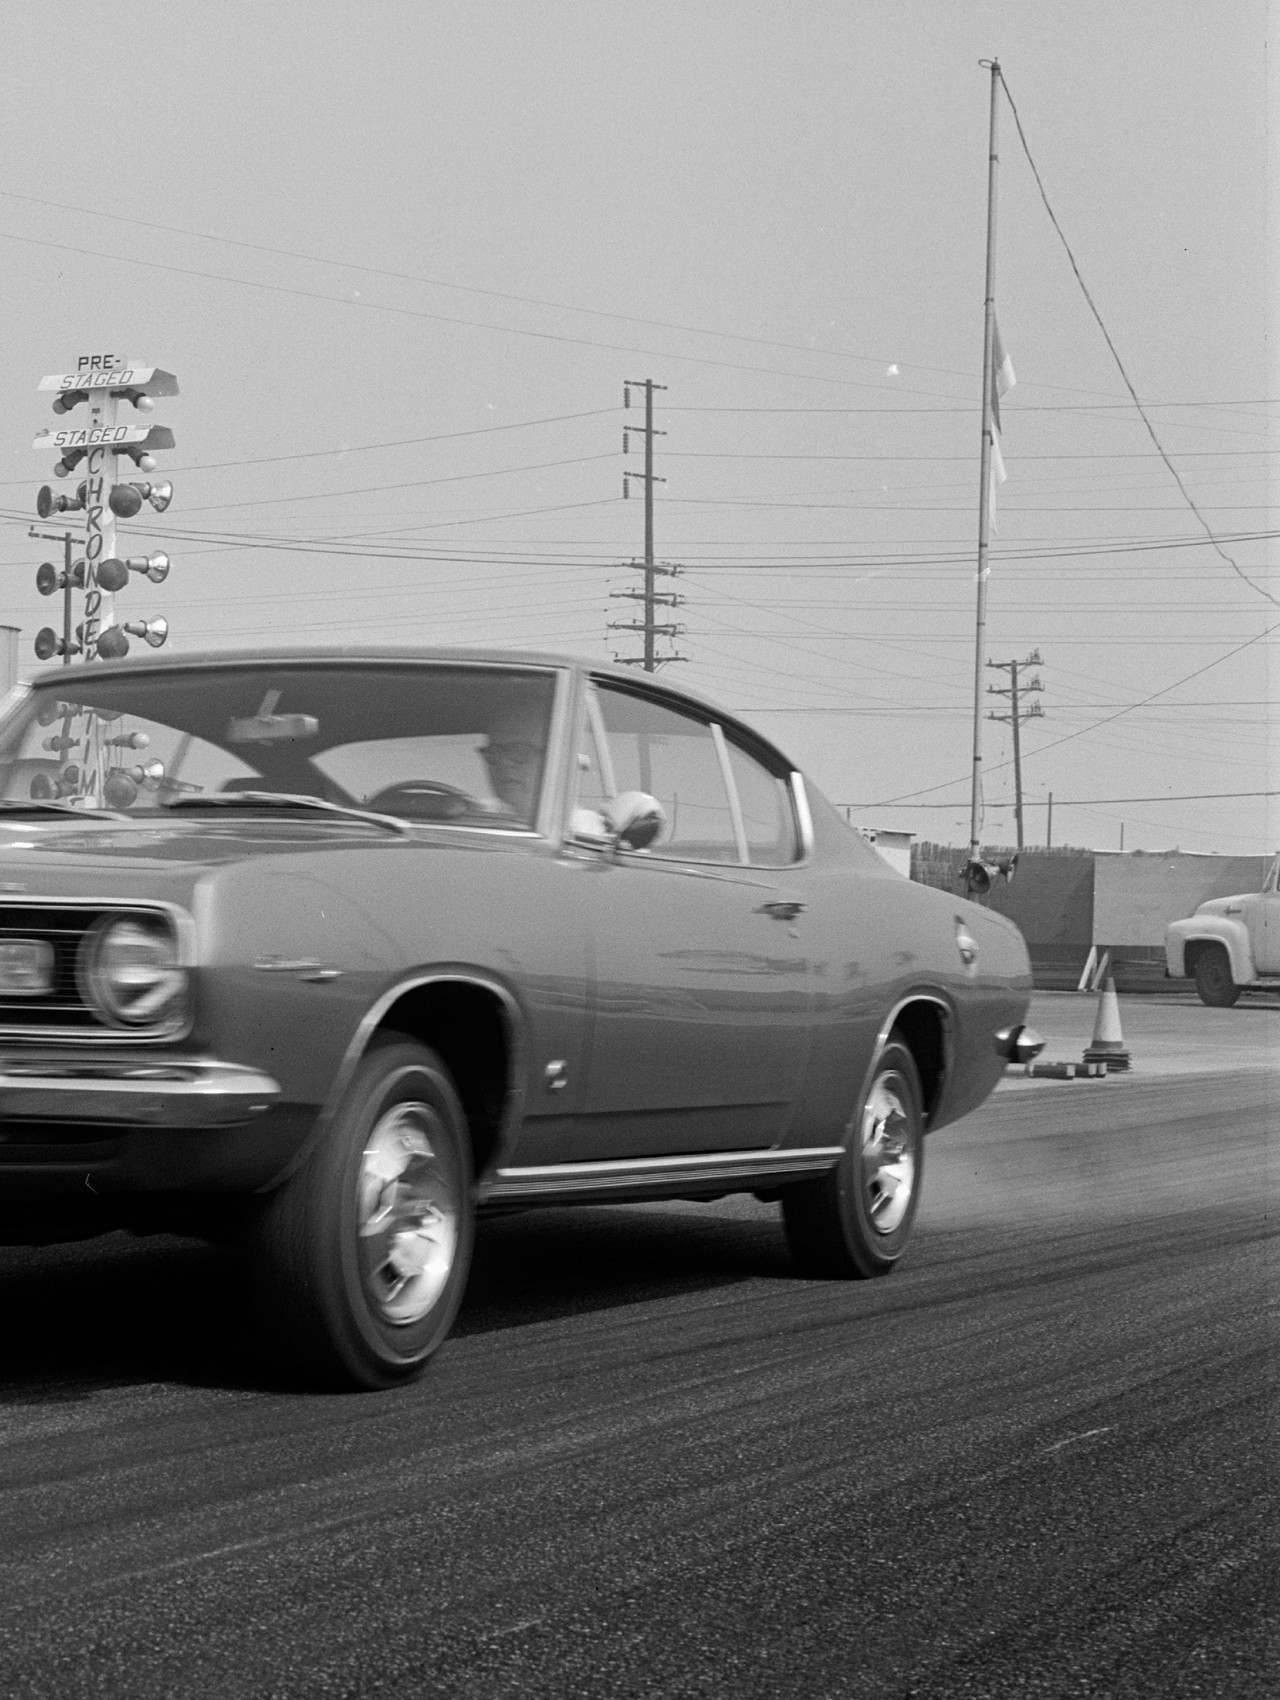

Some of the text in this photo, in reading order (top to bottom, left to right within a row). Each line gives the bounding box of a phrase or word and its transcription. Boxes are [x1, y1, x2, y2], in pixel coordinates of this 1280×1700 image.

[78, 354, 120, 371] PRE-
[60, 370, 134, 389] STAGED
[53, 426, 128, 446] STAGED
